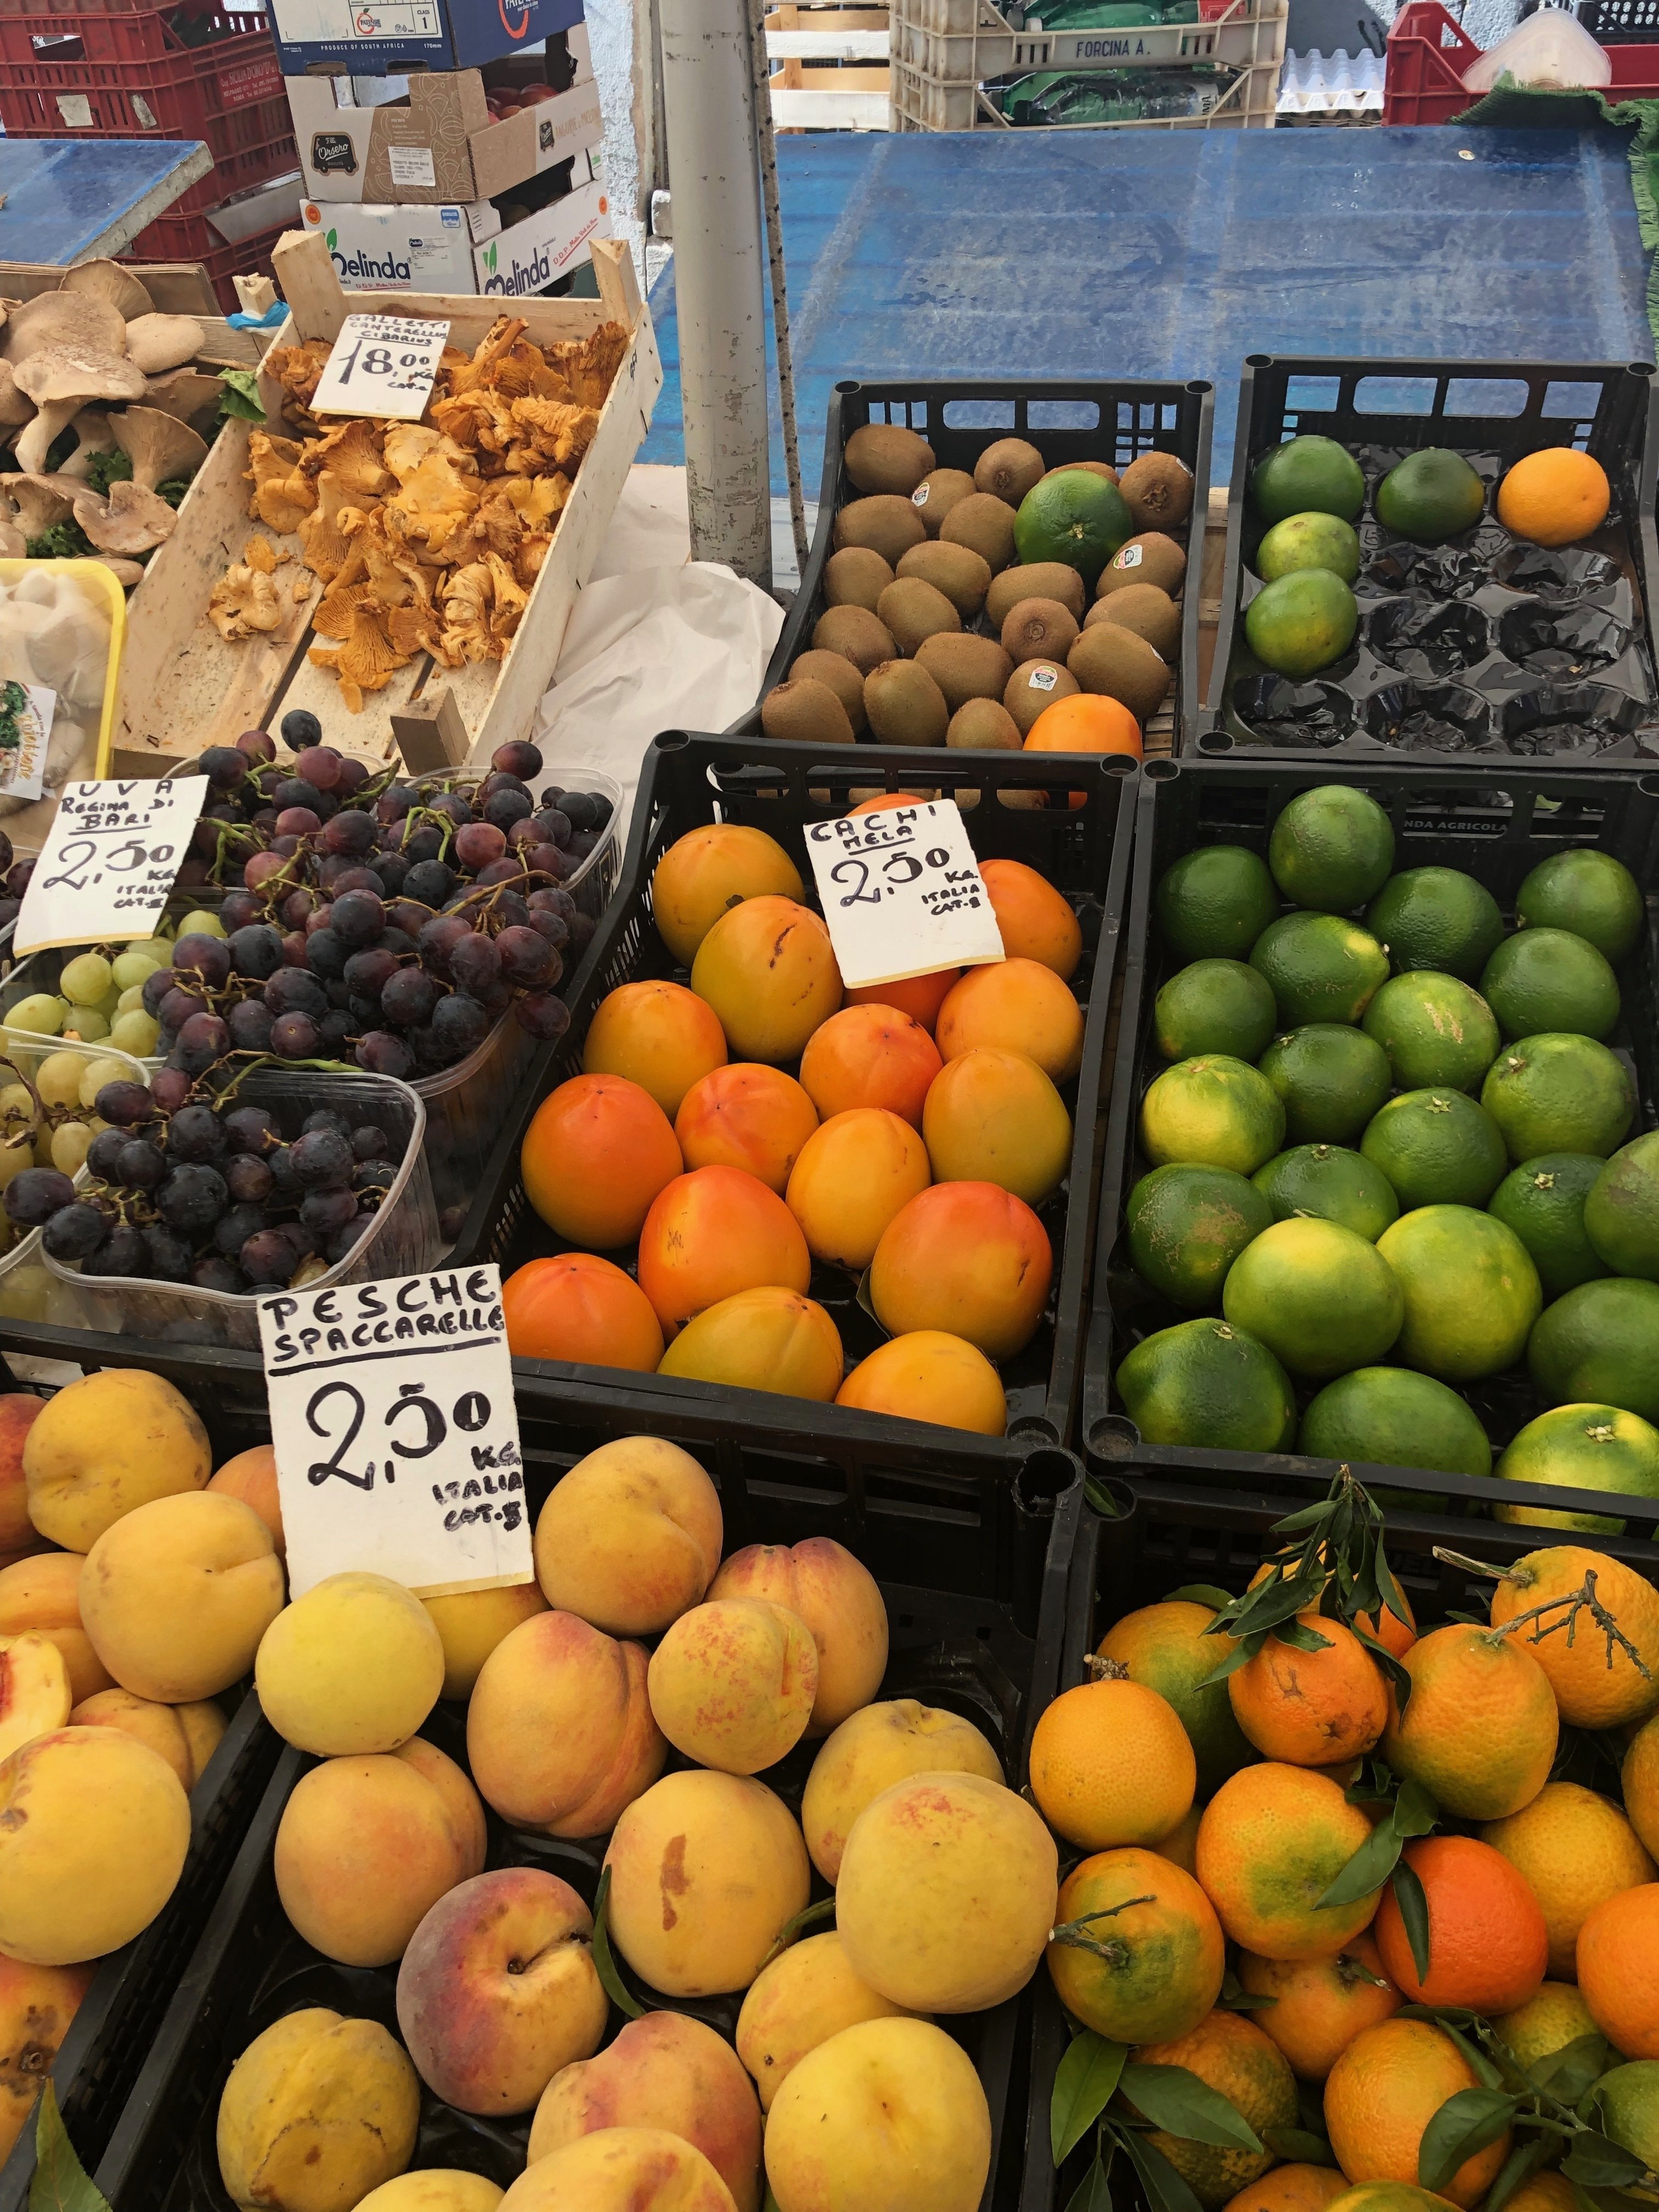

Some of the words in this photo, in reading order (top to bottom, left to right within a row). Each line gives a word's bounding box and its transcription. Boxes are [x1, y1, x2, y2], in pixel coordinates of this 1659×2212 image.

[422, 16, 428, 29] 1
[1076, 40, 1130, 58] FORCINA
[318, 143, 348, 160] Orsero
[485, 247, 550, 296] Melinda
[348, 314, 447, 329] GALLETTI
[76, 814, 150, 830] BARI
[810, 805, 936, 842] CACHI
[1437, 821, 1508, 831] AGRICOLA
[843, 826, 912, 849] MELA
[116, 883, 173, 895] ITALIA
[921, 884, 980, 905] ITALIA
[262, 1269, 496, 1330] PESCHE
[273, 1305, 504, 1362] SPACCARELLE
[432, 1471, 523, 1505] ITALIA
